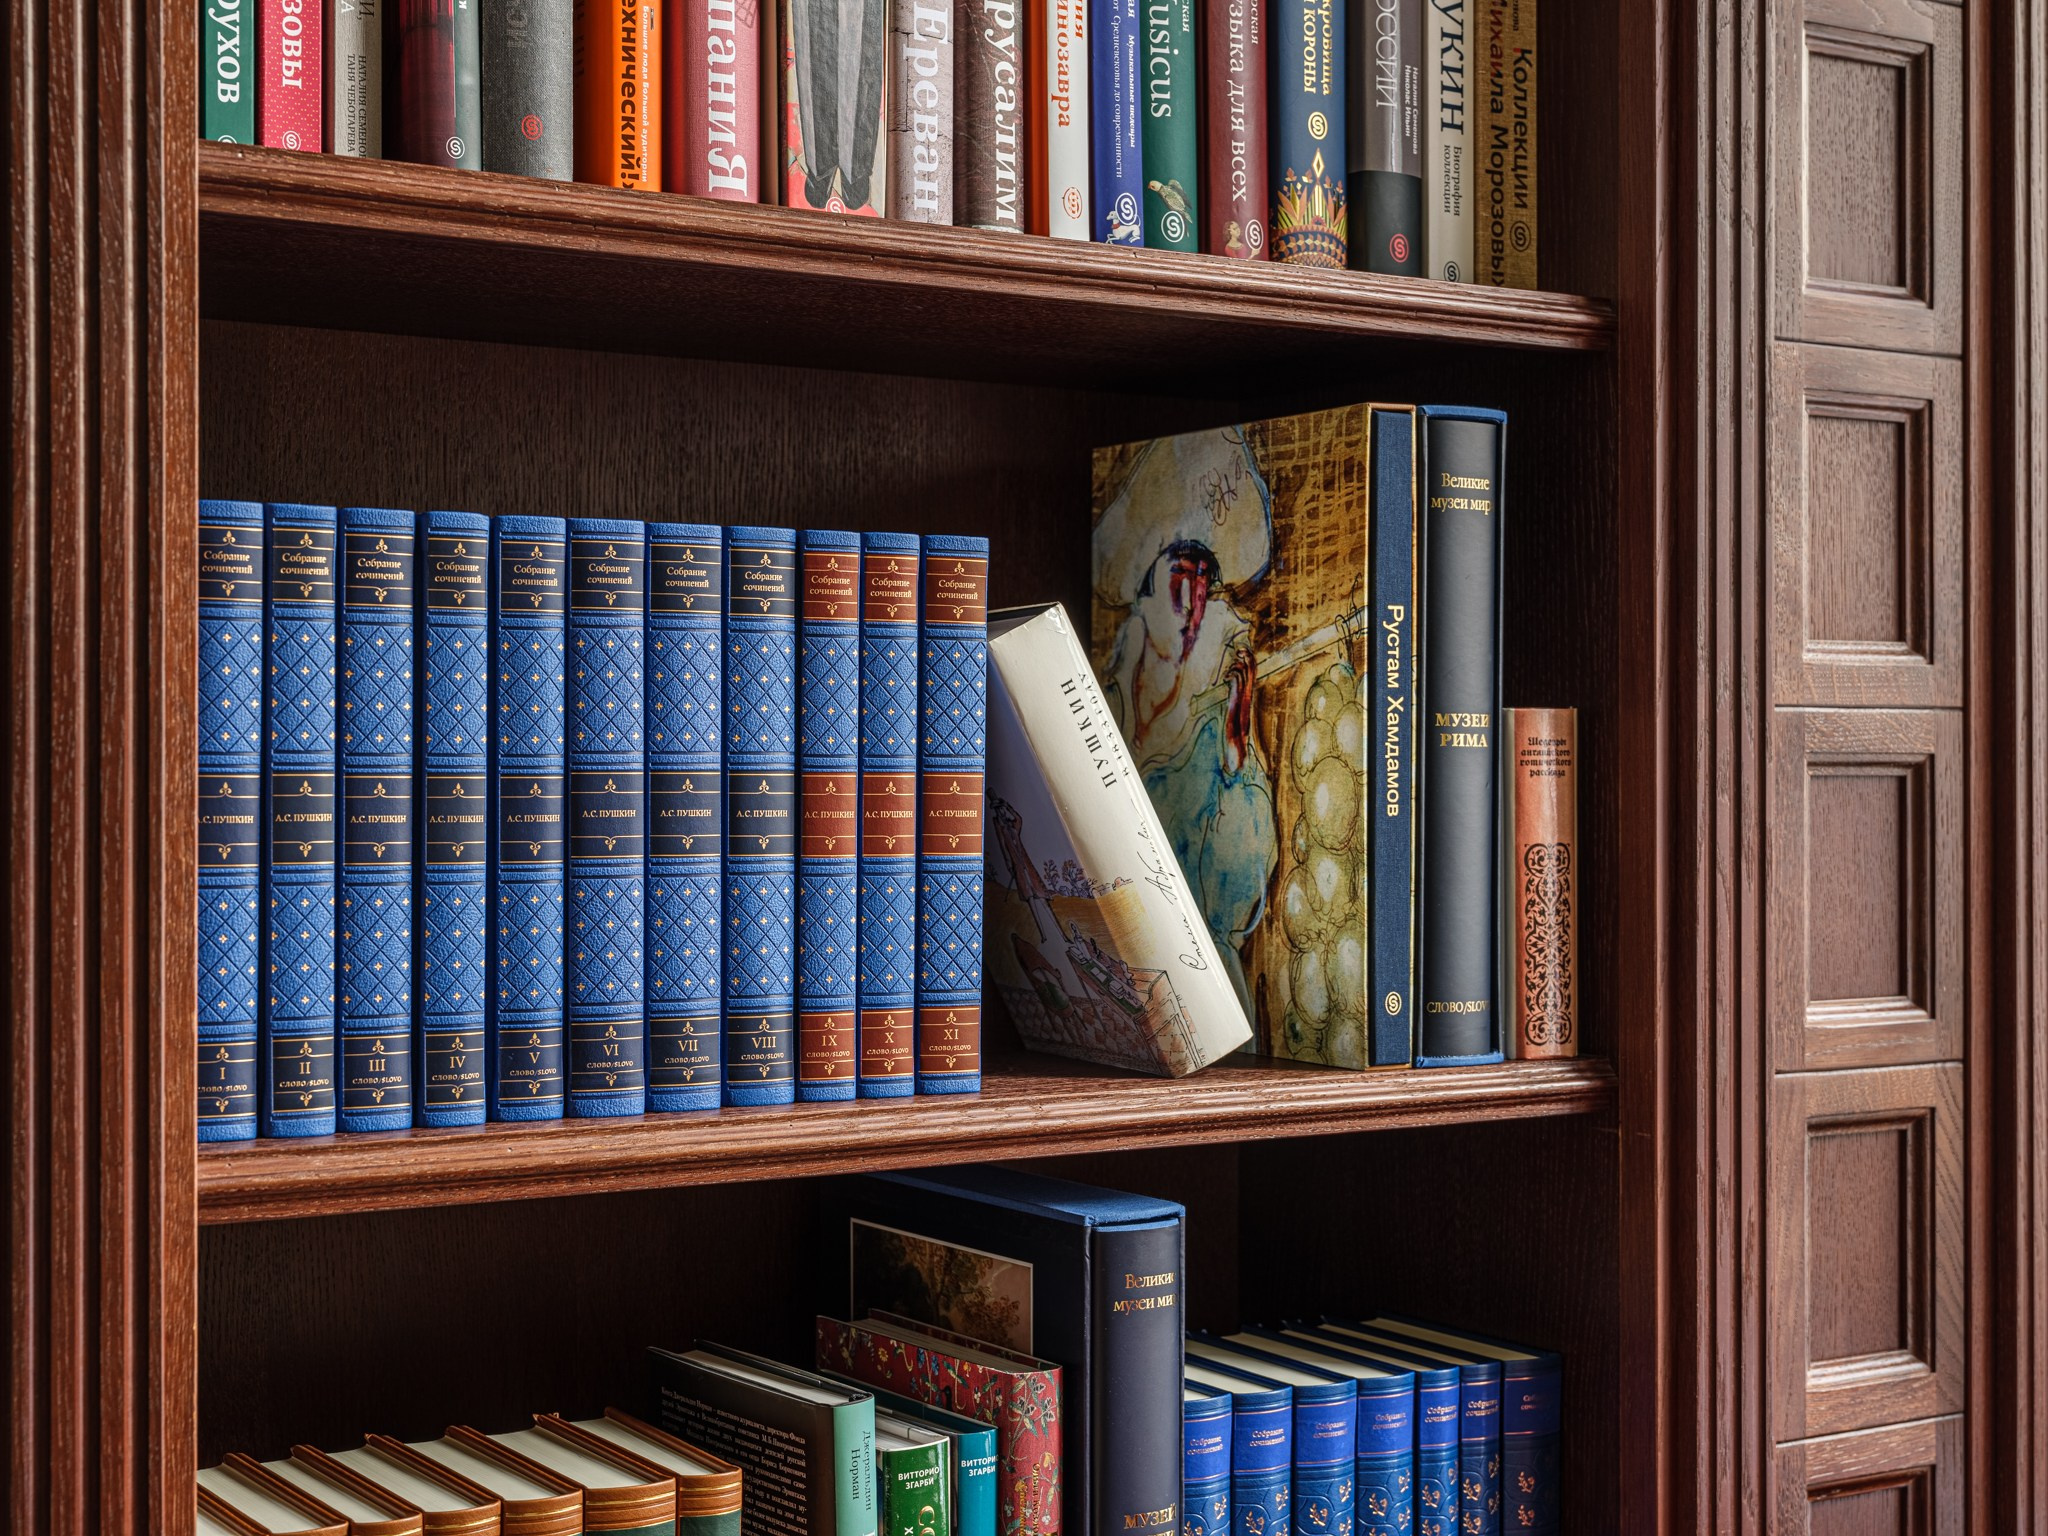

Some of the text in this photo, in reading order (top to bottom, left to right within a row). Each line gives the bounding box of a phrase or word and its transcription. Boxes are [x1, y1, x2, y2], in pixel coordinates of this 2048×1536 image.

[1111, 15, 1122, 88] Средневековья
[1303, 8, 1316, 94] КОРОНЫ
[1128, 34, 1136, 102] Музыкальные
[358, 55, 367, 106] НАТАЛИЯ
[1113, 90, 1121, 102] до
[1404, 65, 1412, 137] Николас Ильин
[347, 54, 356, 153] ТАНЯ ЧЕБОТАРЕВА
[641, 82, 649, 127] Большой
[902, 2, 948, 214] Ереван
[1227, 80, 1245, 132] для
[1511, 47, 1533, 209] Коллекции
[1113, 103, 1122, 178] современности
[1231, 140, 1248, 202] всех
[1443, 144, 1453, 213] коллекции
[1451, 146, 1463, 216] Биография
[1441, 472, 1490, 491] Великие
[1430, 497, 1469, 513] музеи
[203, 550, 250, 564] Собрание
[281, 552, 327, 566] Собрание
[201, 563, 253, 575] сочинений
[357, 557, 402, 571] Собрание
[436, 560, 480, 574] Собрание
[513, 563, 556, 576] Собрание
[588, 562, 630, 576] Собрание
[279, 565, 329, 577] сочинений
[355, 569, 405, 582] сочинений
[666, 566, 707, 578] Собрание
[744, 570, 783, 583] Собрание
[434, 572, 482, 585] сочинений
[512, 575, 559, 588] сочинений
[586, 574, 633, 587] сочинений
[665, 577, 710, 589] сочинений
[810, 574, 851, 587] Собрание
[871, 576, 910, 589] Собрание
[938, 578, 977, 591] Собрание
[742, 581, 786, 593] сочинений
[809, 585, 853, 597] сочинений
[869, 587, 912, 599] сочинений
[936, 589, 978, 601] сочинений
[1382, 604, 1405, 818] Рустам Хамдамов
[1434, 712, 1491, 728] МУЗЕИ
[1060, 678, 1117, 788] ПУШКИН
[1439, 732, 1489, 748] РИМА
[198, 815, 254, 824] .С. ПУШКИН
[275, 813, 333, 823] А.С. ПУШКИН
[350, 815, 407, 824] А.С. ПУШКИН
[429, 815, 484, 824] А.С. ПУШКИН
[507, 814, 560, 823] А.С. ПУШКИН
[582, 809, 636, 819] А.С. ПУШКИН
[659, 809, 712, 818] А.С. ПУШКИН
[736, 810, 788, 818] А.С. ПУШКИН
[804, 810, 855, 819] А.С. ПУШКИН
[864, 810, 914, 819] А.С. ПУШКИН
[929, 809, 978, 818] А.С. ПУШКИН
[821, 1034, 837, 1047] IX
[885, 1031, 895, 1044] X
[943, 1028, 959, 1041] XI
[678, 1039, 698, 1053] VII
[751, 1035, 777, 1049] VIII
[603, 1044, 619, 1057] VI
[449, 1055, 466, 1069] IV
[529, 1051, 541, 1064] V
[299, 1061, 311, 1075] II
[369, 1059, 386, 1072] III
[219, 1067, 226, 1080] I
[198, 1084, 248, 1093] ЛОВО/SLOVO
[1113, 1294, 1176, 1316] музеи ми
[850, 1447, 861, 1501] Норман
[862, 1430, 873, 1511] Джеральдин
[897, 1465, 940, 1482] ВИТТОРИО
[968, 1464, 996, 1477] ЗГАРБИ
[905, 1477, 935, 1490] ЗГАРБИ
[1123, 1502, 1177, 1530] МУЗЕЙ
